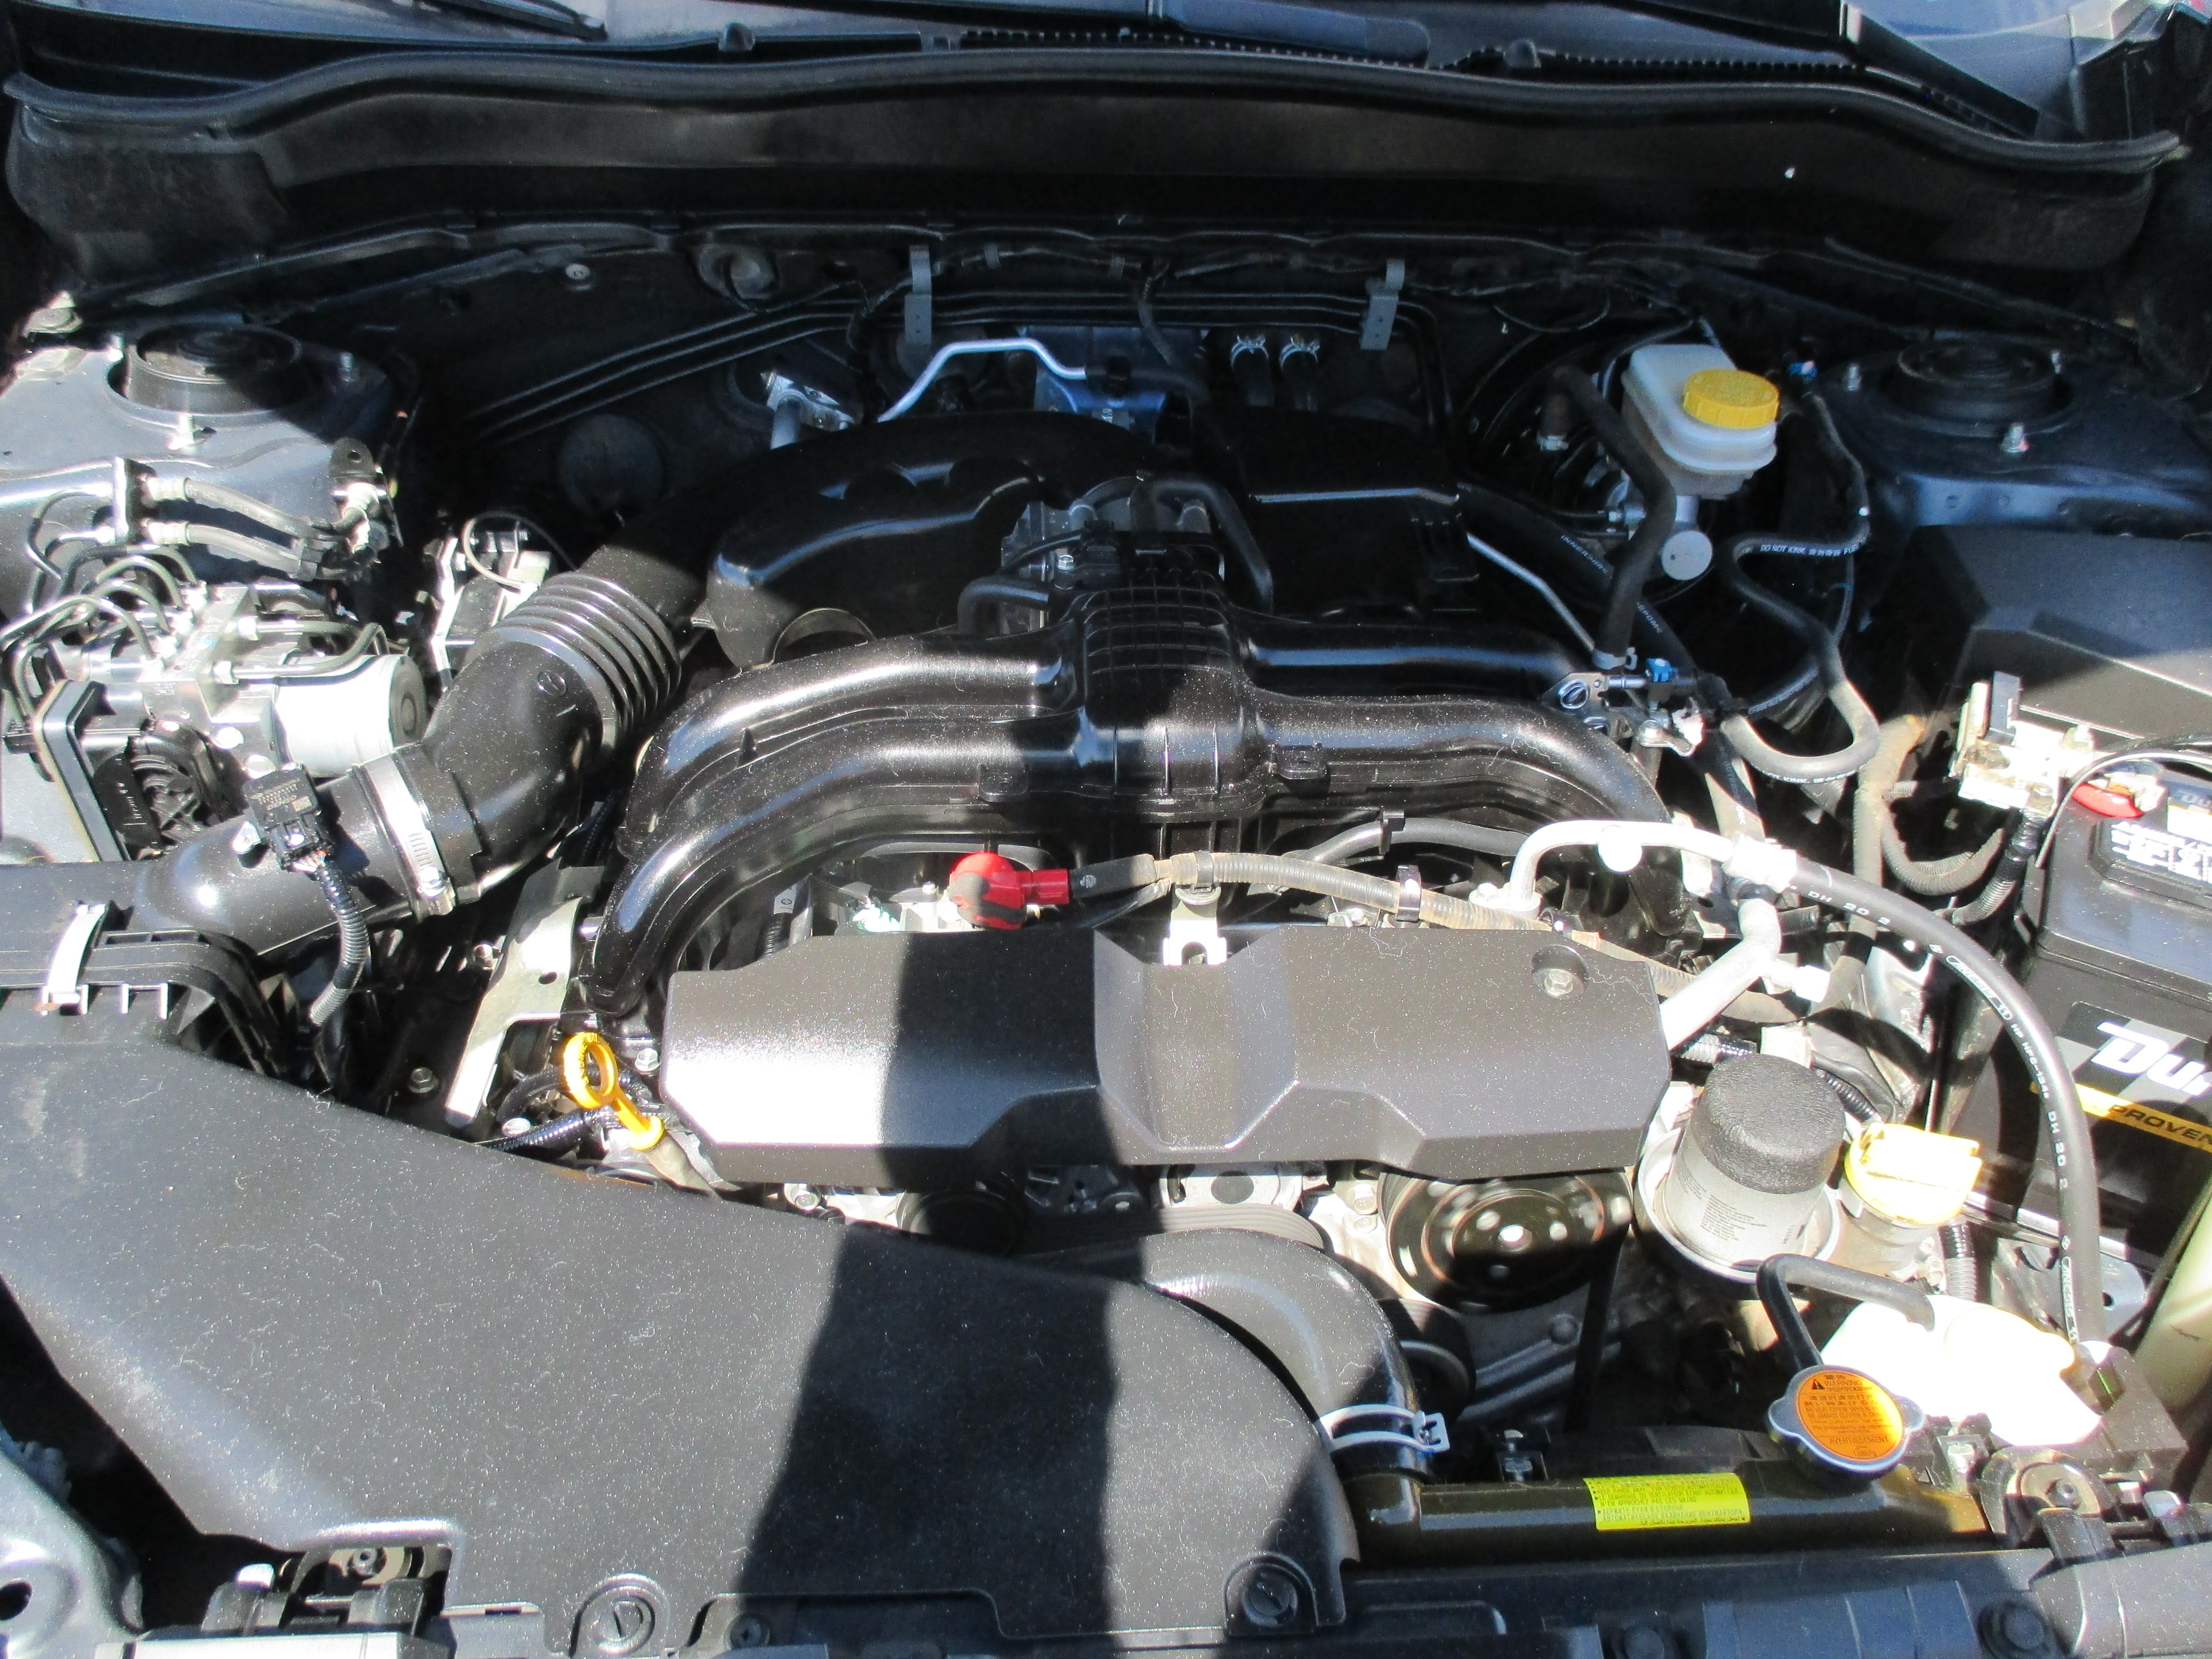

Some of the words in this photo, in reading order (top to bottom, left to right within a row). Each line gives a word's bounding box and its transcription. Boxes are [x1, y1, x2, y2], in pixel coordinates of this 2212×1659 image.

[1807, 890, 1833, 903] DH
[1843, 902, 1870, 915] 20
[1877, 916, 1891, 926] 2
[2010, 1023, 2024, 1039] HP
[2047, 1110, 2061, 1134] DH
[2054, 1142, 2066, 1166] 20
